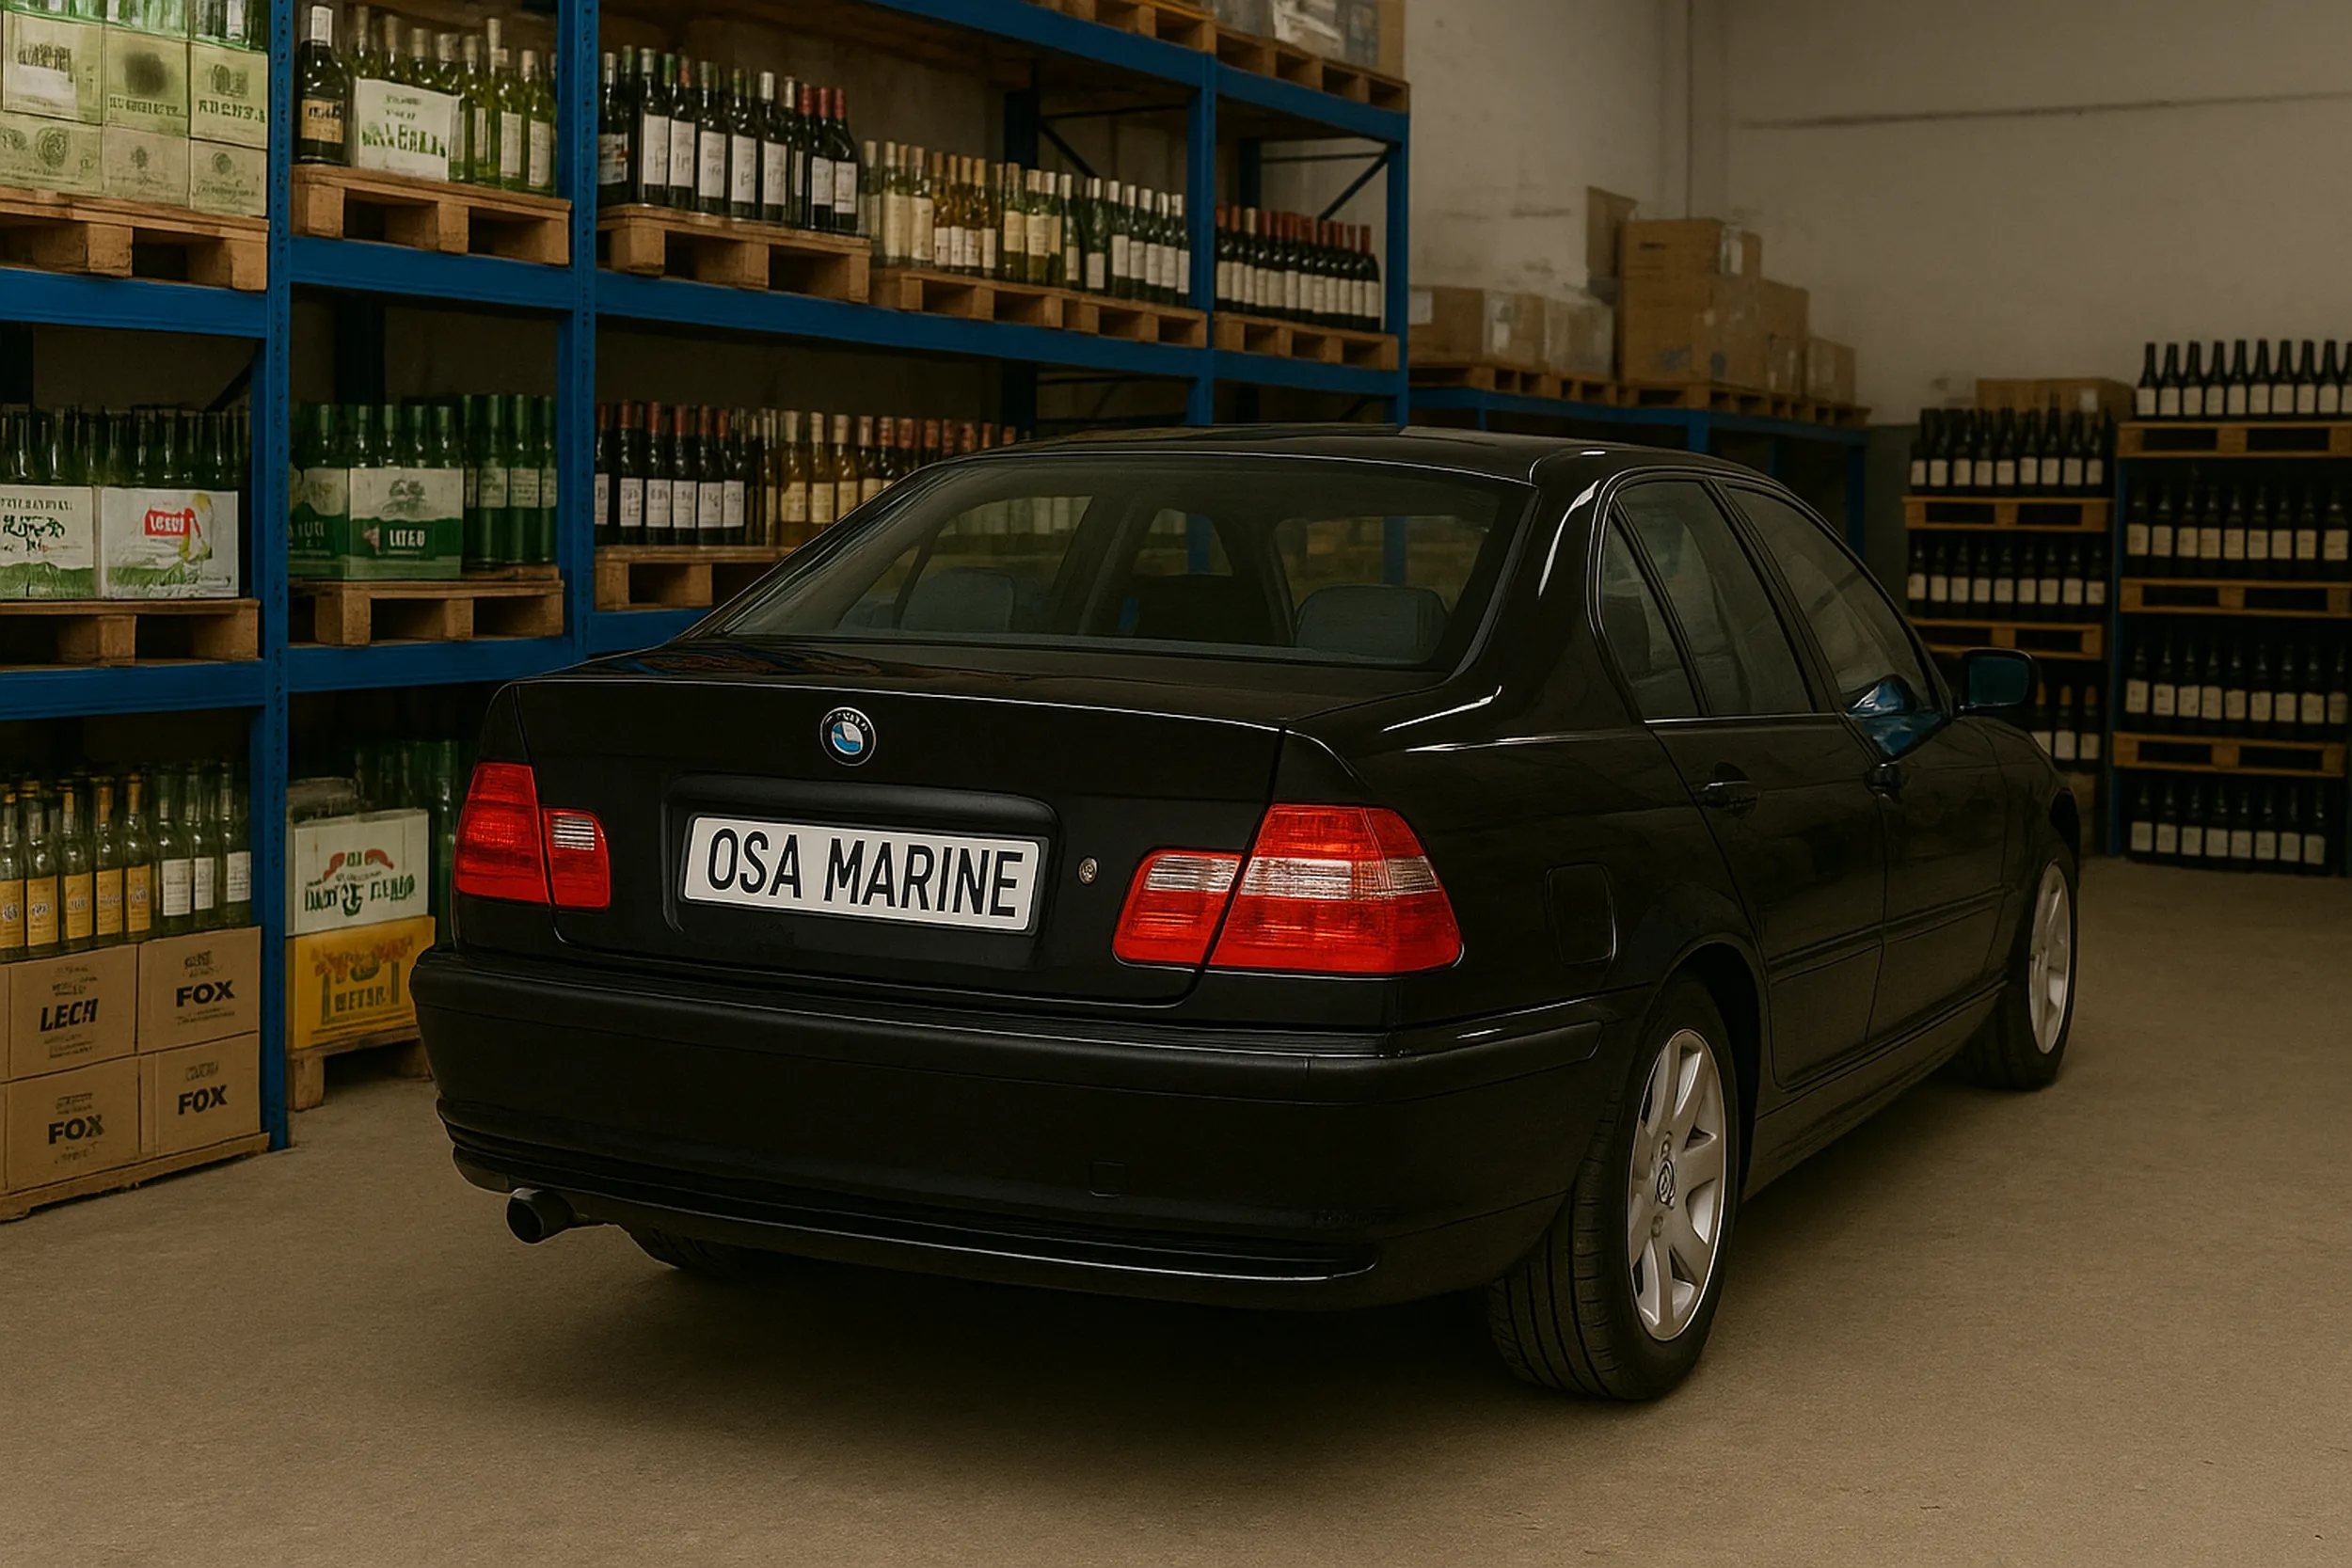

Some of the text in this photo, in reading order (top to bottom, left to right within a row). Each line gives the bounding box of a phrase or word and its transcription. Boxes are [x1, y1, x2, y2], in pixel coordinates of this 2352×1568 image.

[707, 828, 1024, 918] OSA MARINE
[176, 979, 236, 1008] FOX
[177, 1084, 228, 1116] FOX
[48, 1114, 105, 1145] FOX
